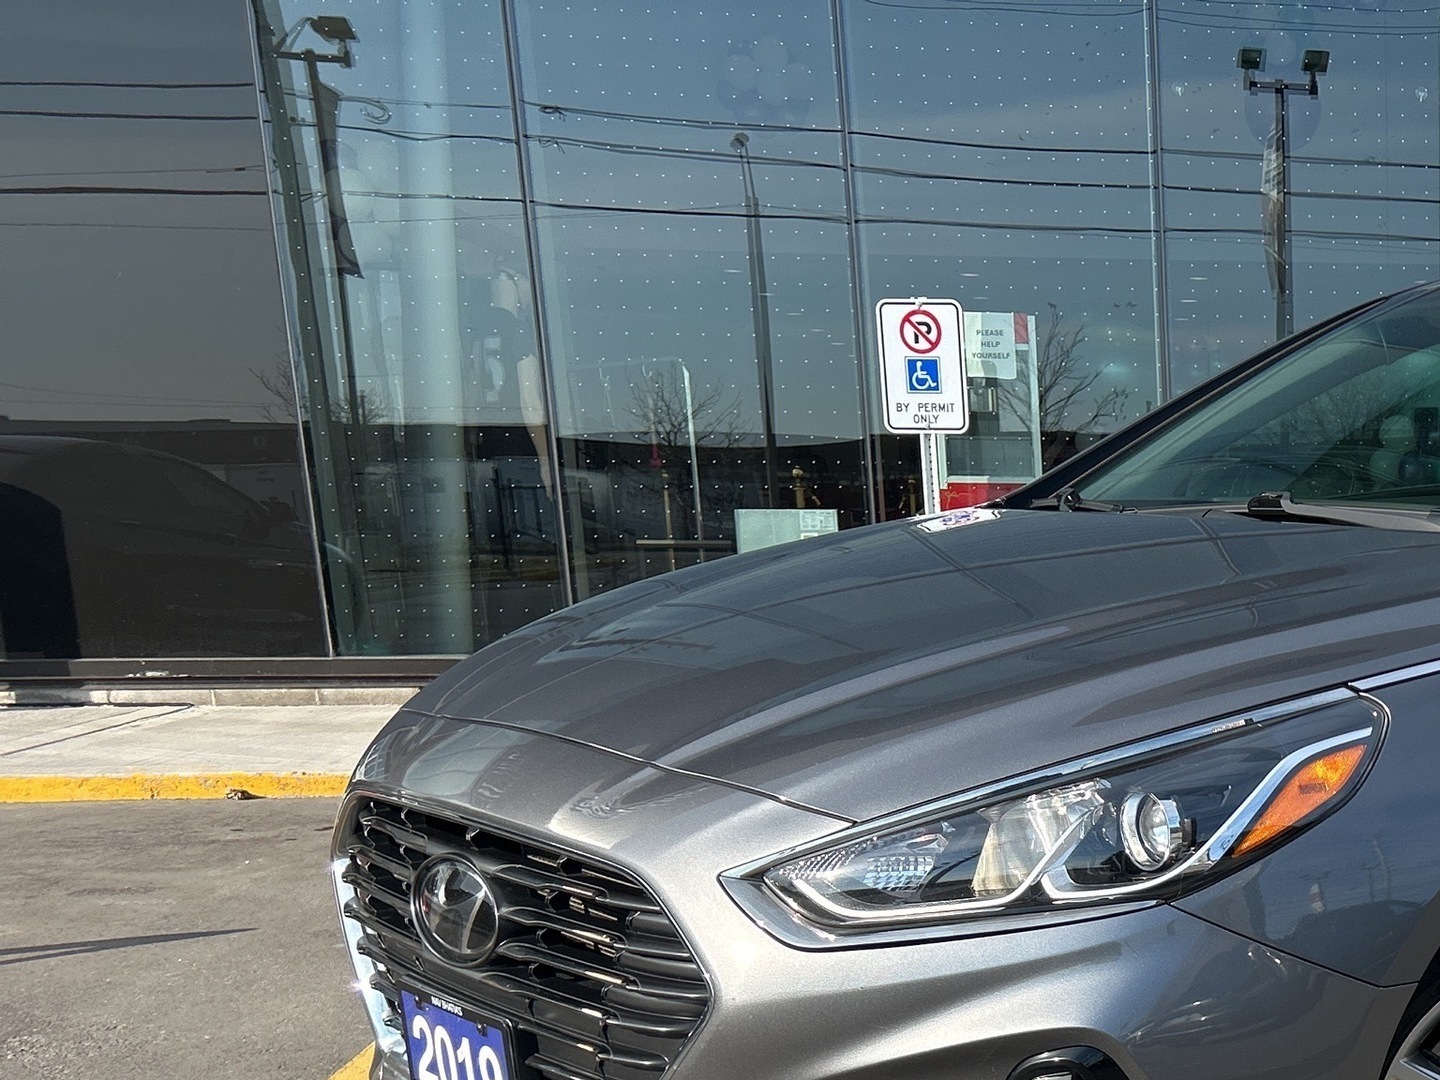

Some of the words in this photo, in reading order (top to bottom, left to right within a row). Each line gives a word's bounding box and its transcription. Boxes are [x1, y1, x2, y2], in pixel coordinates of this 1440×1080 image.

[976, 329, 1004, 337] PLEASE
[972, 352, 1011, 360] YOURSELF
[896, 402, 910, 412] BY
[918, 403, 955, 413] PERMIT
[913, 414, 940, 424] ONLY
